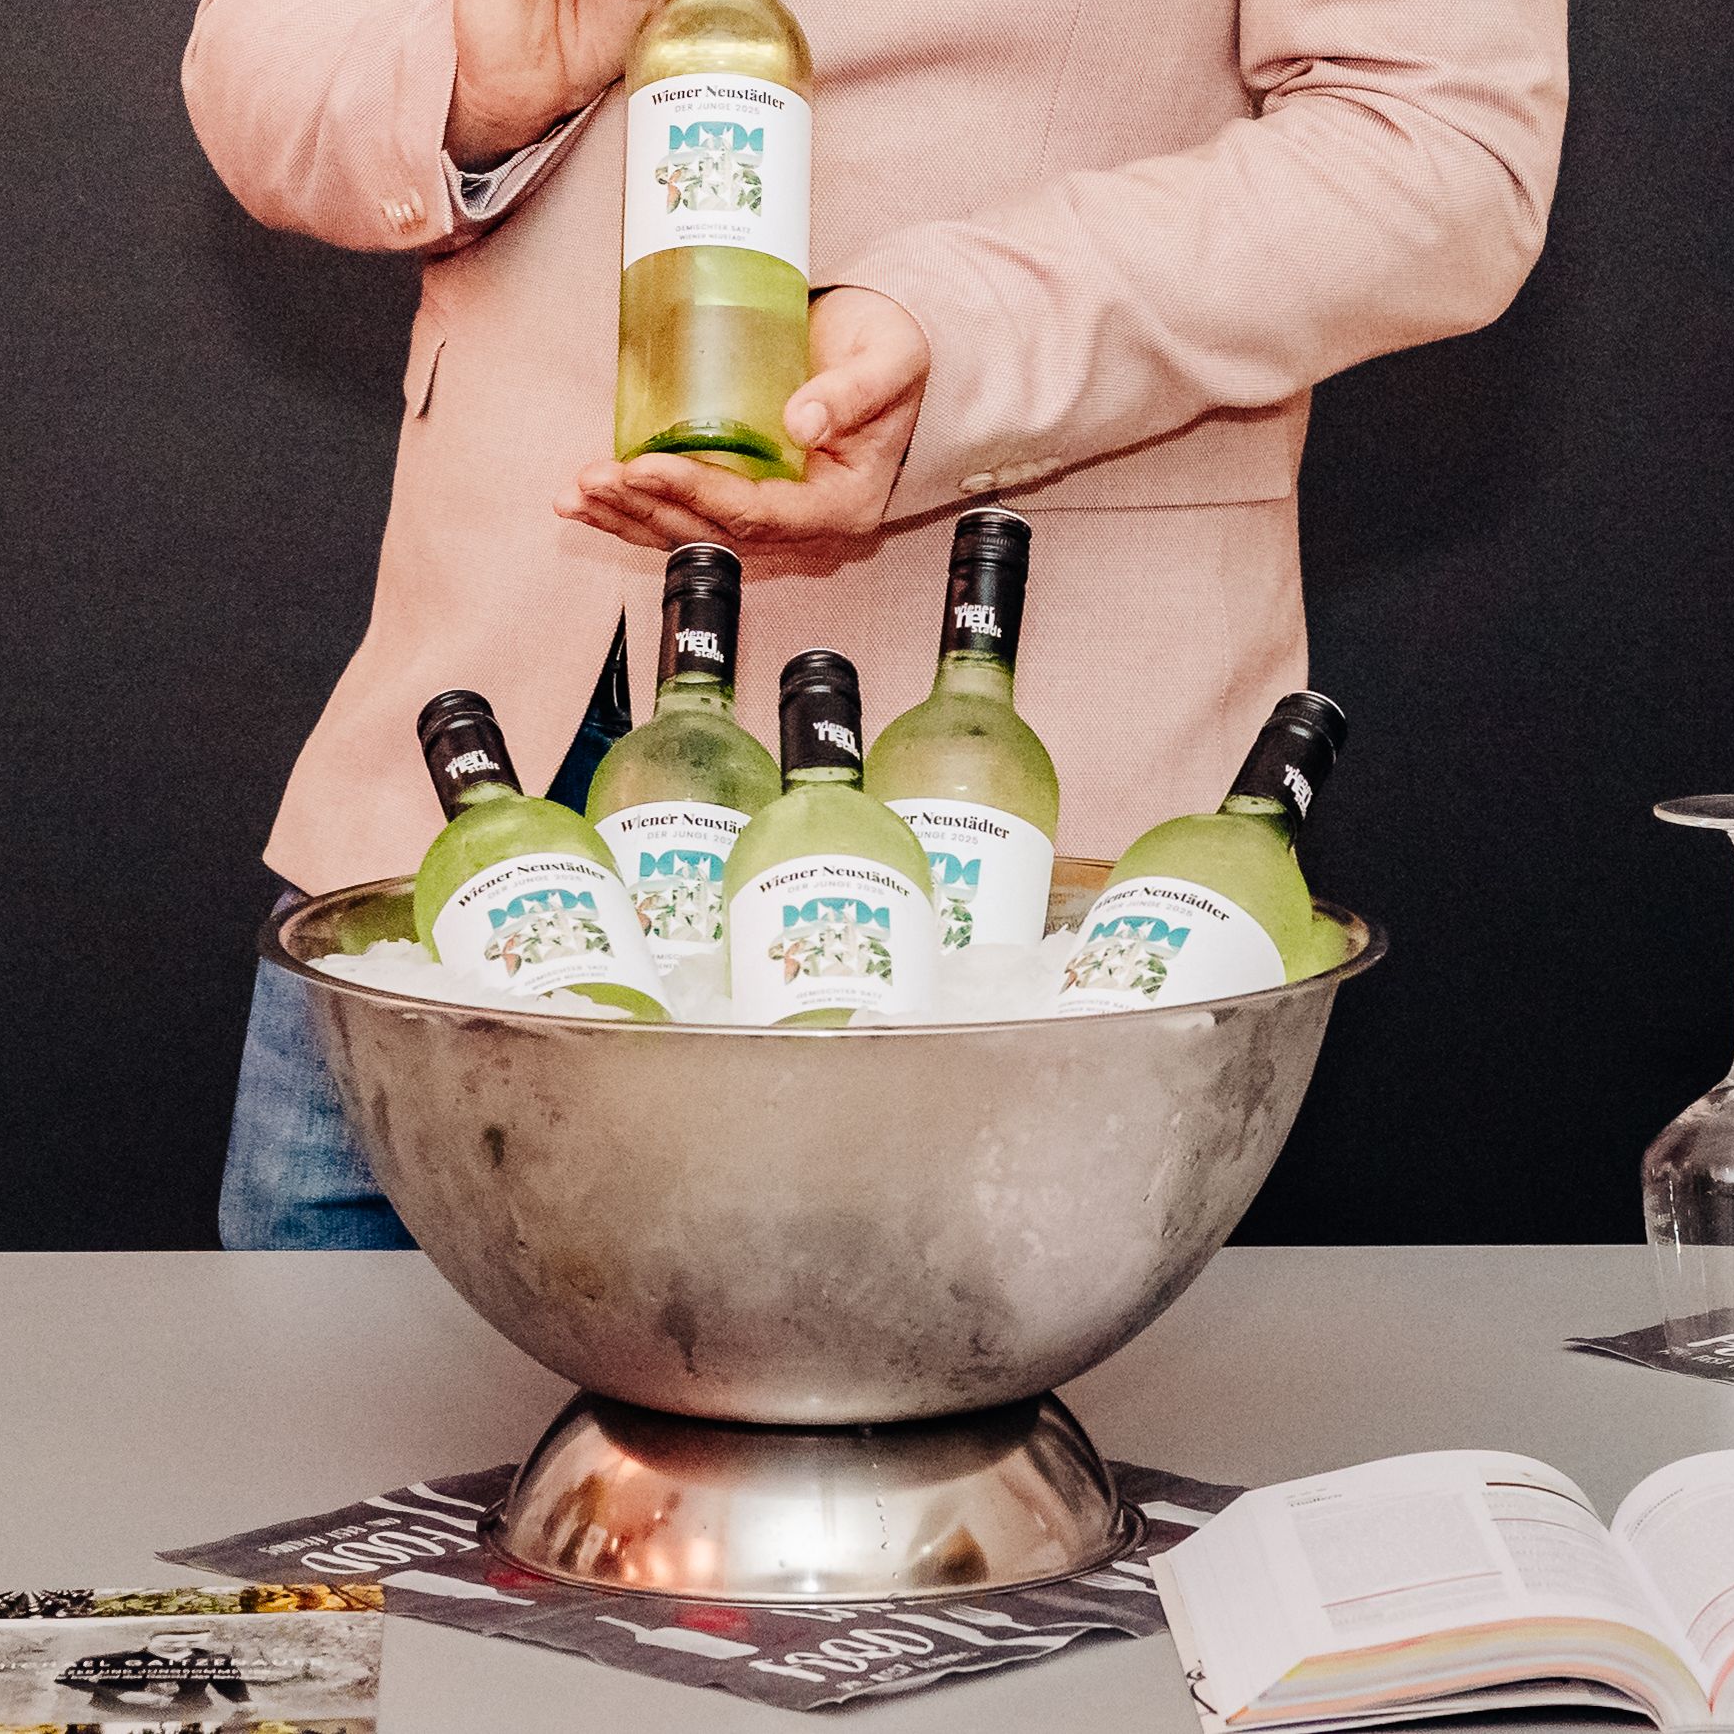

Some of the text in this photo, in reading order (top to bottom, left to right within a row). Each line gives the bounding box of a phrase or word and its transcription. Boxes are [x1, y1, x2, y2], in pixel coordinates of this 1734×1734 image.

[651, 85, 785, 110] Wiener Neustädter
[675, 103, 761, 115] DER JUNGE 2025
[621, 813, 678, 833] Wiener
[922, 811, 1010, 840] Neustädter
[916, 831, 979, 845] UNGE 2025
[458, 861, 606, 907] Wiener Neustädter
[759, 866, 910, 897] Wiener Neustädter
[1142, 887, 1230, 922] Neustädter
[300, 1524, 482, 1576] FOOD
